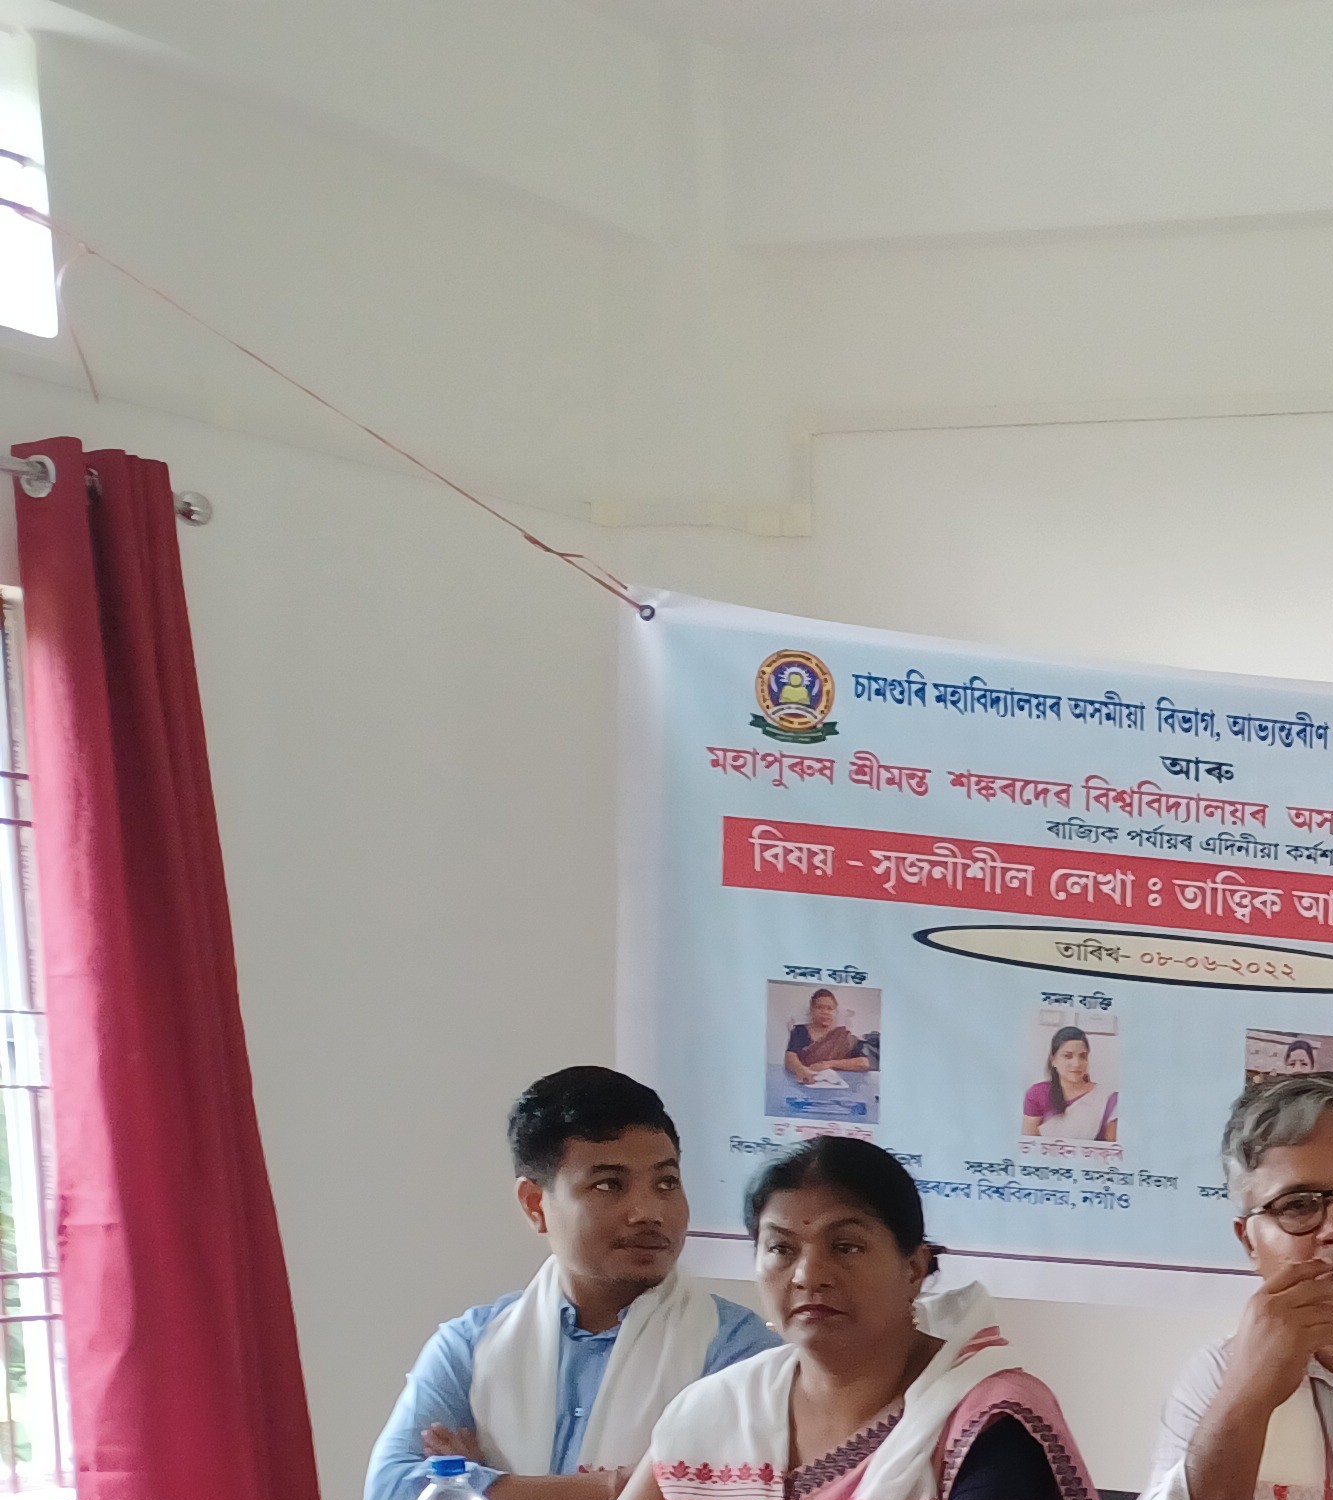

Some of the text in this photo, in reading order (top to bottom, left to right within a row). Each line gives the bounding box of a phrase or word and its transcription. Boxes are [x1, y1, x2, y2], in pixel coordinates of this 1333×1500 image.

[1067, 690, 1146, 731] অসমীয়া
[1155, 696, 1221, 741] বিভাগ,
[748, 825, 836, 877] বিষয়
[869, 842, 1035, 897] সৃজনীশীল
[1050, 868, 1135, 908] লেখা
